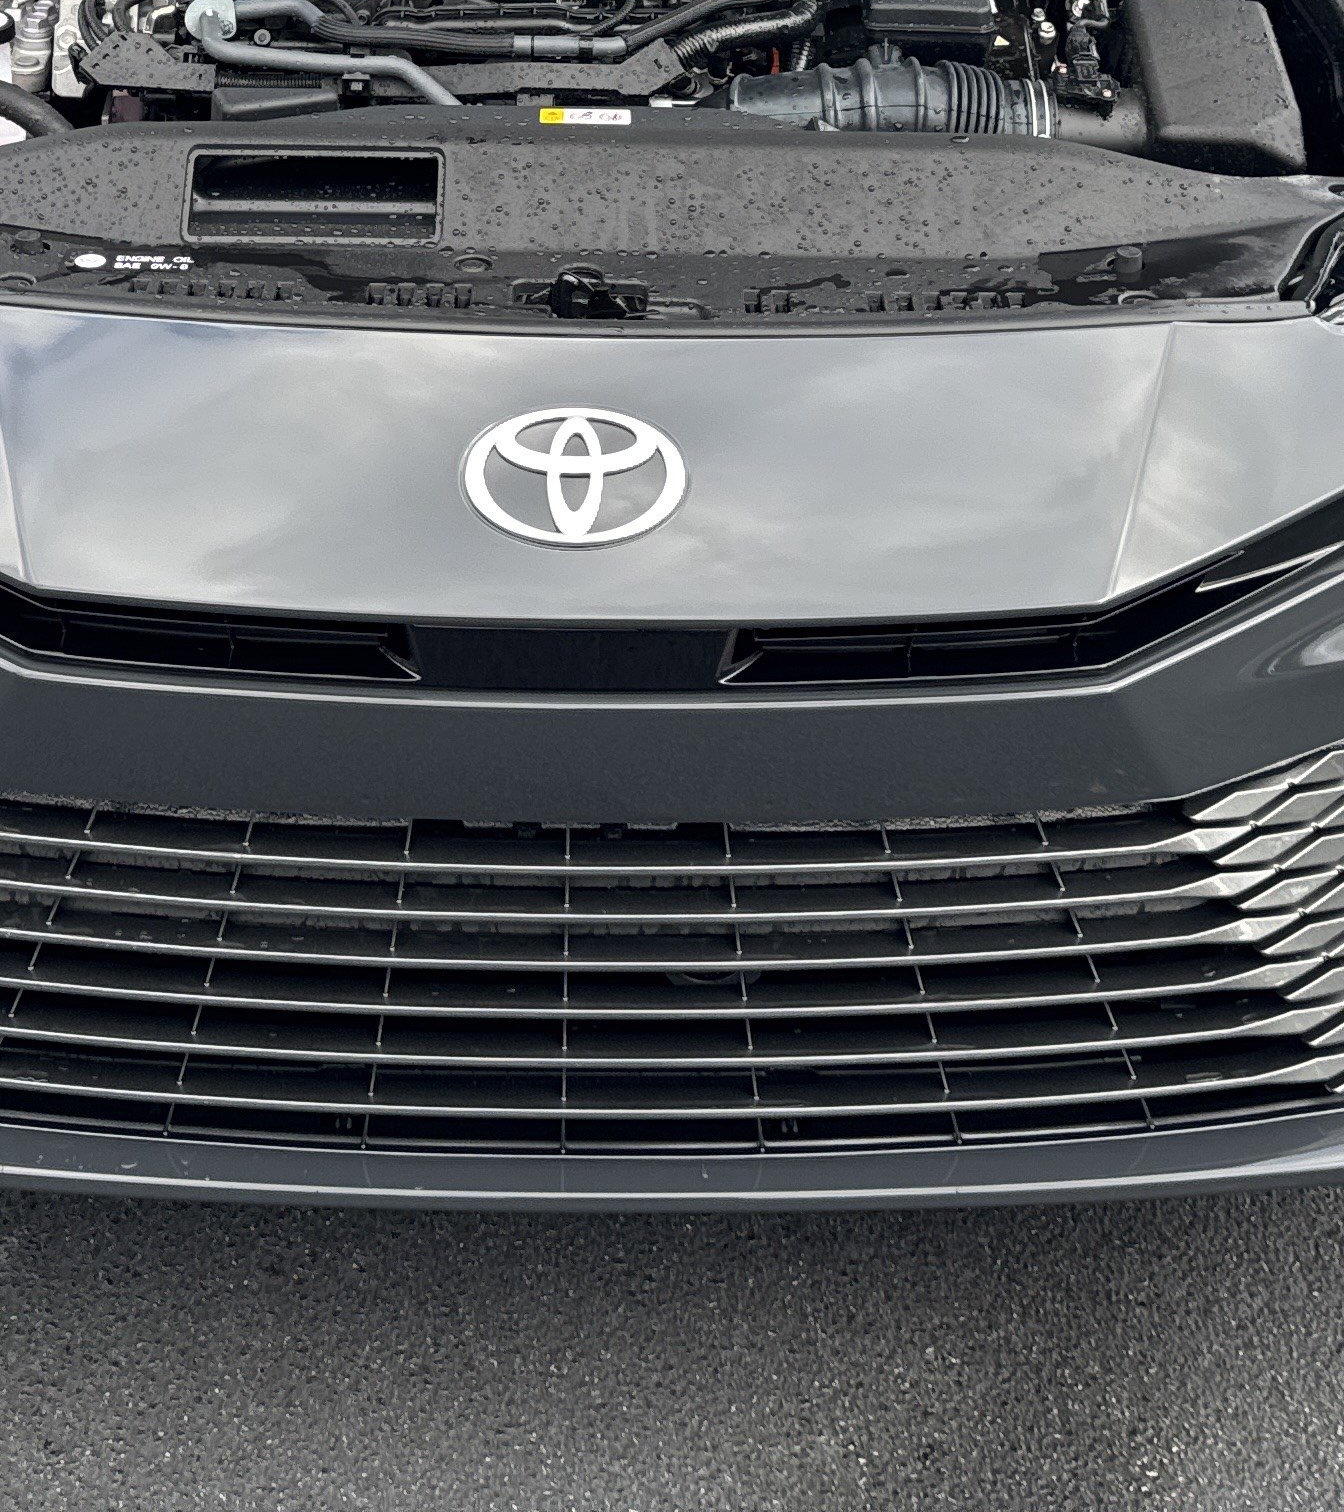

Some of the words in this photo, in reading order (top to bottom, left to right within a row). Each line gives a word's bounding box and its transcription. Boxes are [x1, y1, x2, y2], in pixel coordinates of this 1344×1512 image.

[116, 254, 166, 263] ENGINE
[172, 256, 195, 264] OIL
[113, 262, 142, 270] SAE
